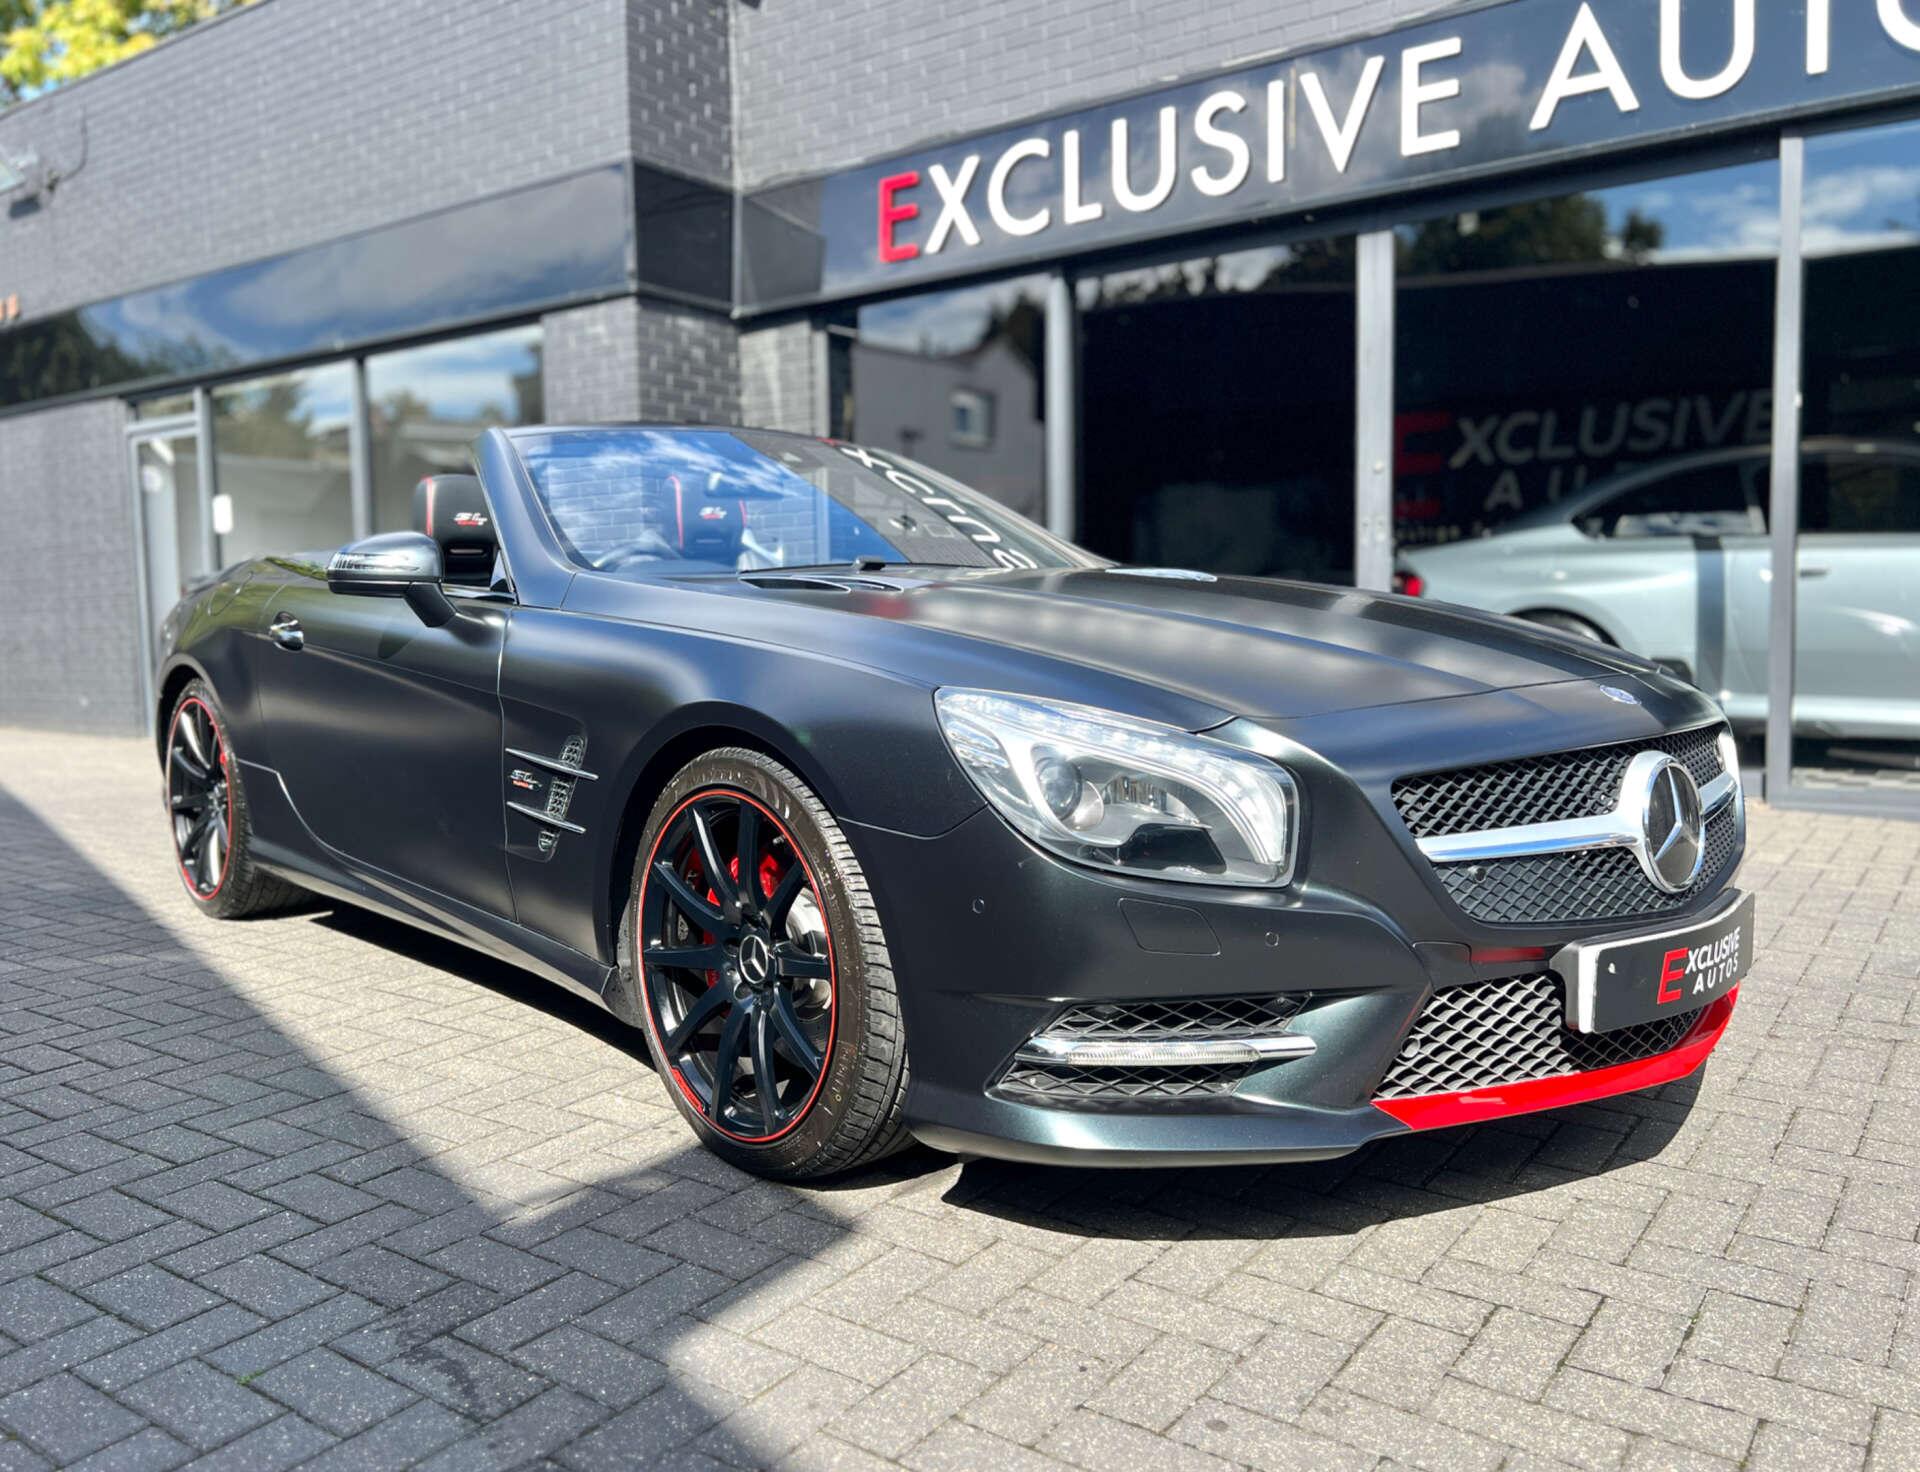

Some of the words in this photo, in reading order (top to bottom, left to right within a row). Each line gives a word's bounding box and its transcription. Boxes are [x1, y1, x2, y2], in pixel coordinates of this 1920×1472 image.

[878, 37, 1462, 264] EXCLUSIVE
[1528, 0, 1920, 131] AU
[1394, 388, 1772, 518] EXCLUSIVE
[1657, 926, 1741, 1005] EXCLUSIVE
[1692, 951, 1739, 995] AUTOS
